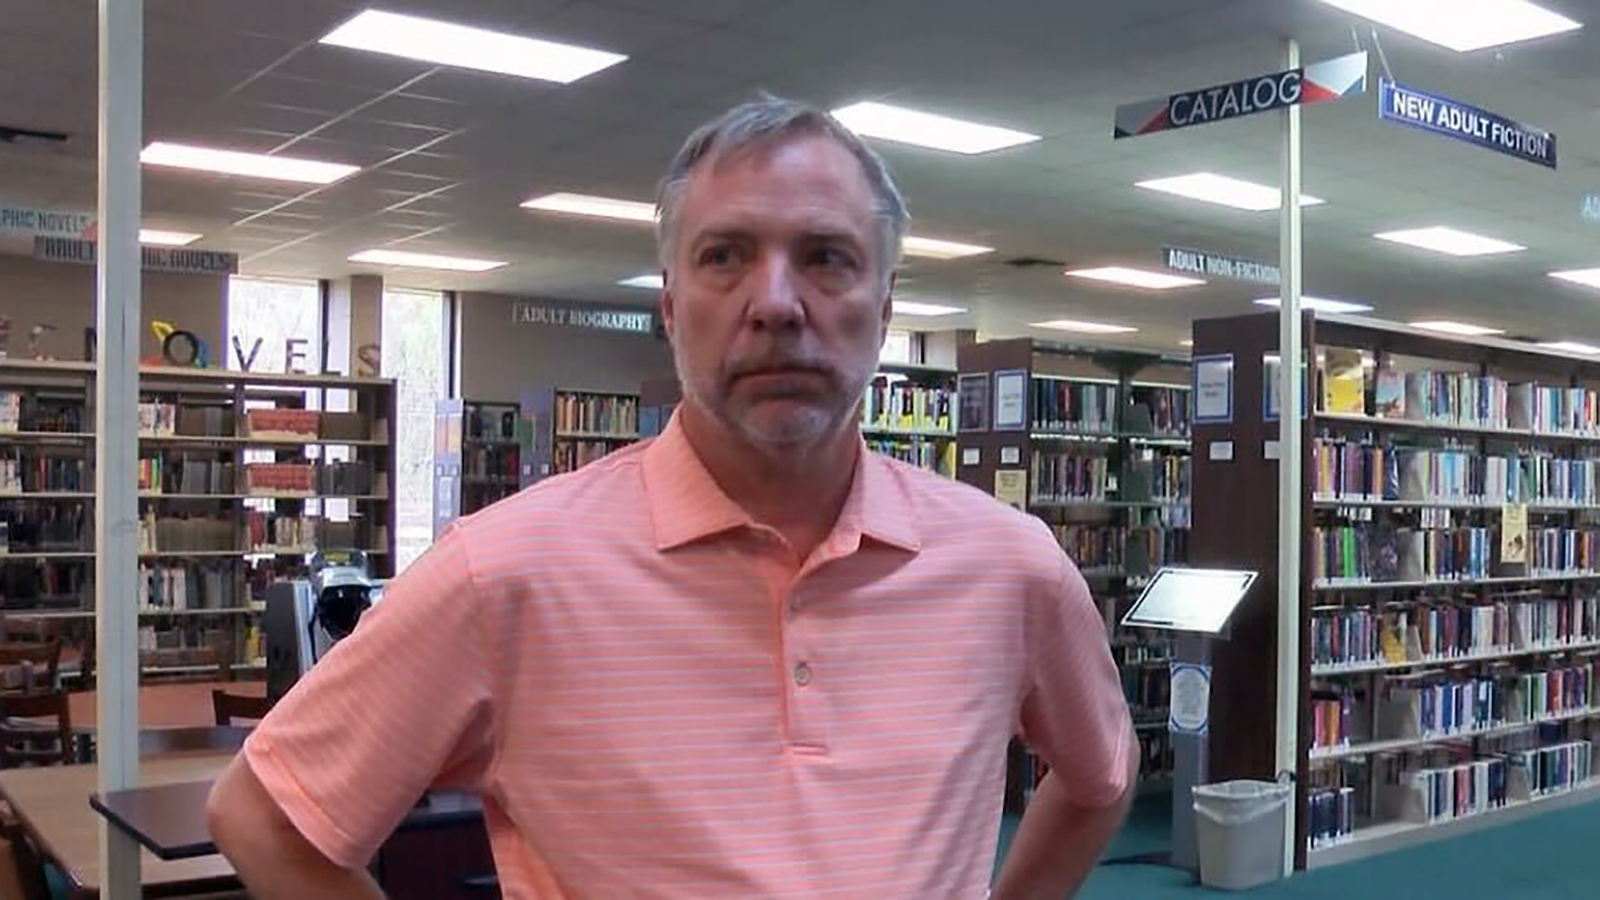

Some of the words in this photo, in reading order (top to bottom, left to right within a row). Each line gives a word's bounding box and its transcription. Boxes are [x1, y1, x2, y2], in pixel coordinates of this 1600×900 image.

[1170, 73, 1301, 125] CATALOG
[1393, 90, 1435, 121] NEW
[1437, 105, 1489, 140] ADULT
[1491, 123, 1547, 158] FICTION
[1, 208, 34, 229] PHIC
[38, 211, 88, 234] NOVELS
[1168, 248, 1205, 273] ADULT
[521, 304, 564, 325] ADULT
[568, 309, 643, 331] BIOGRAPHY
